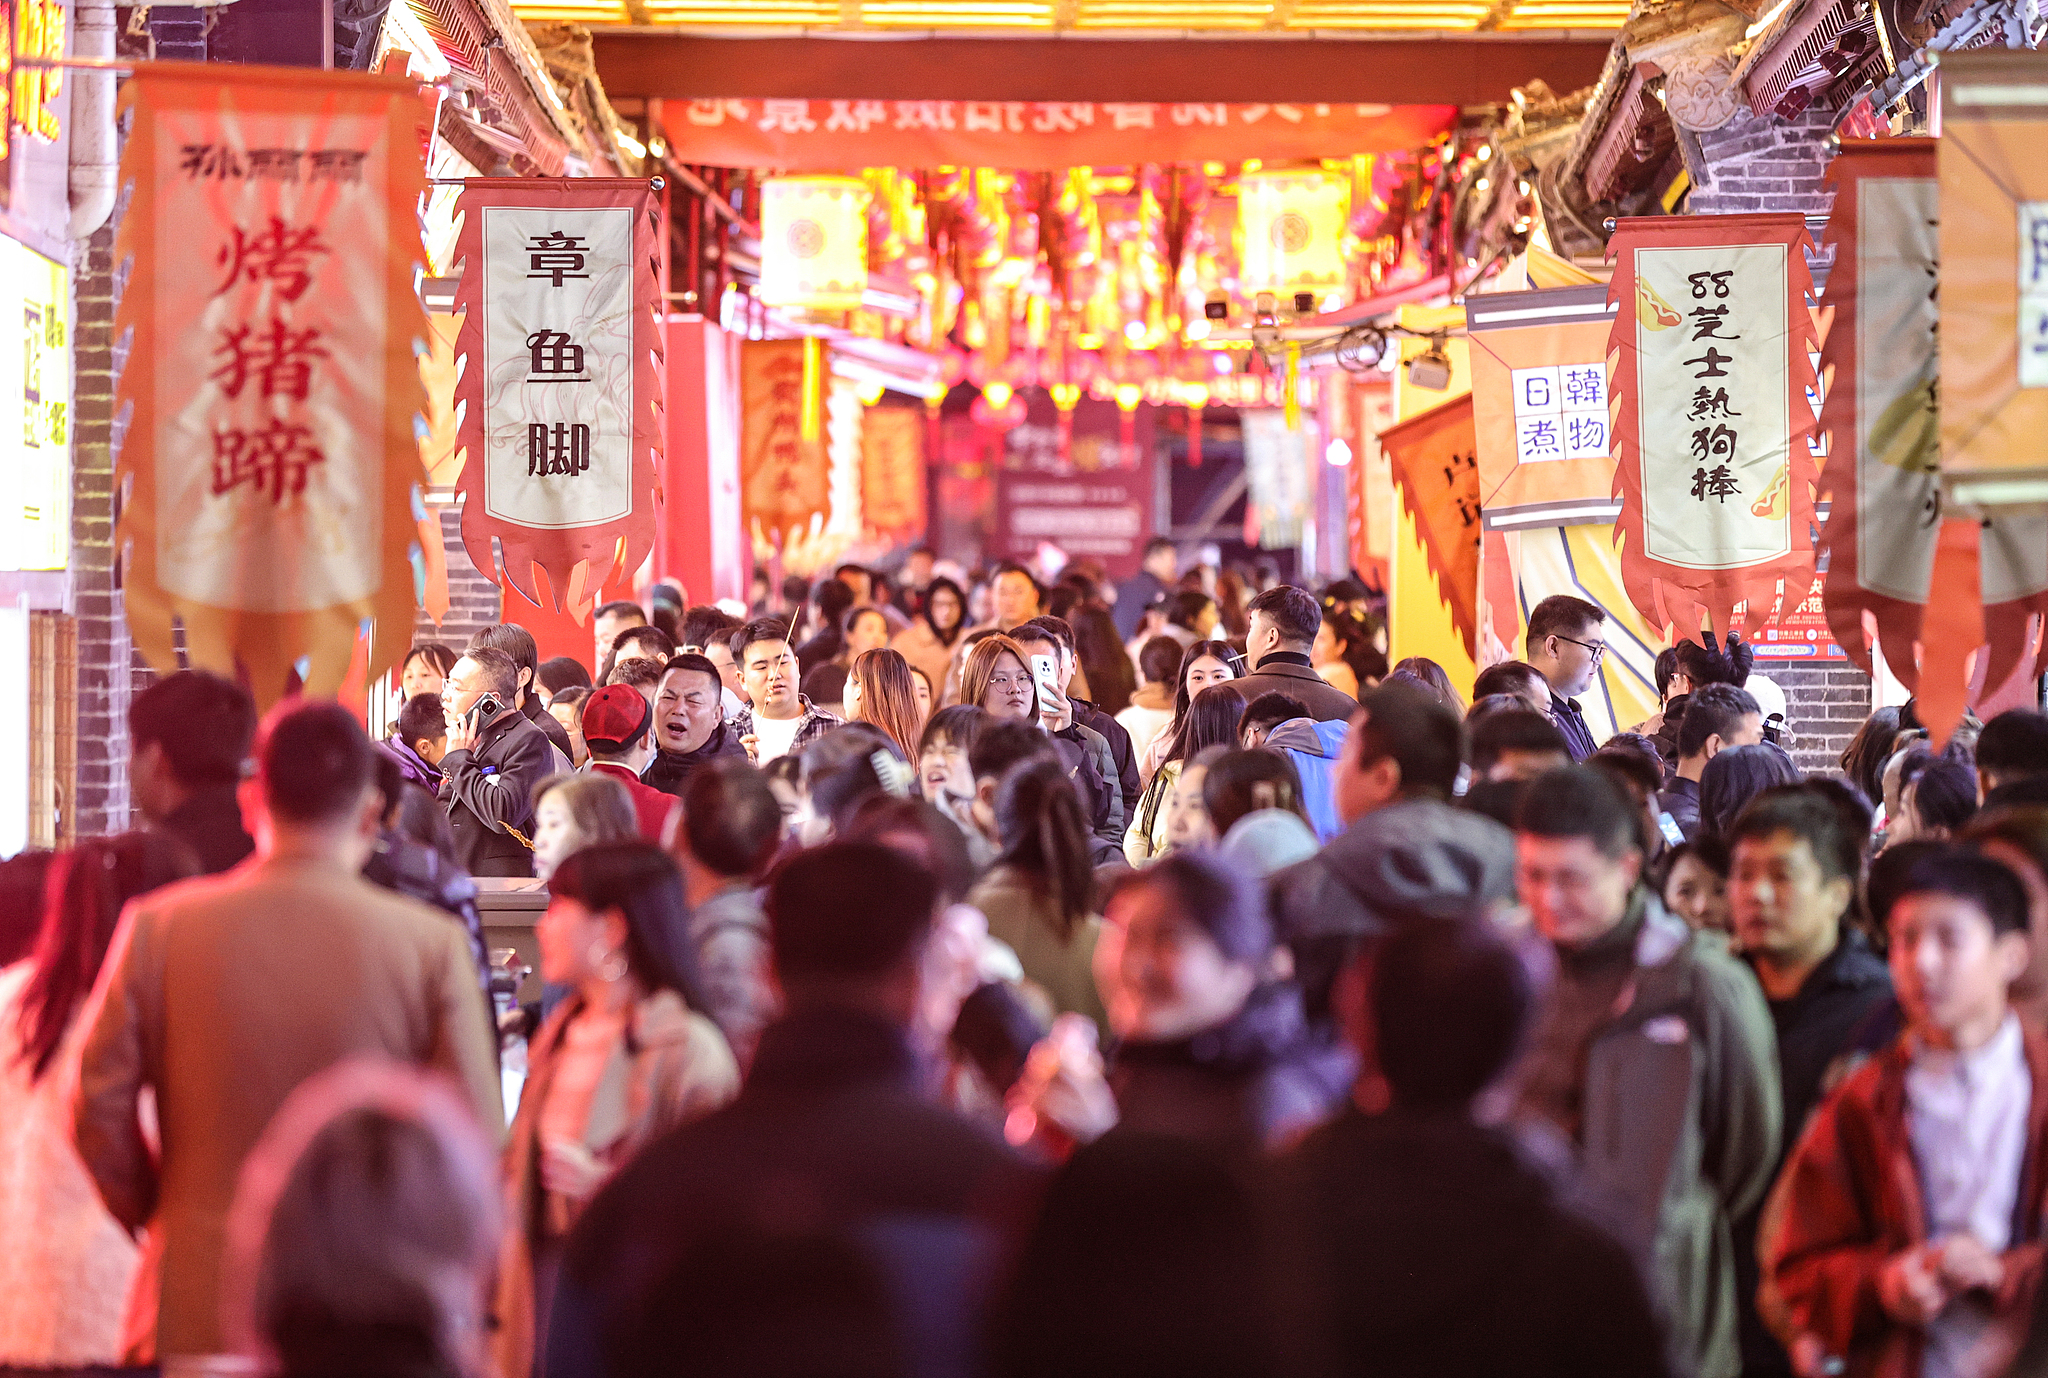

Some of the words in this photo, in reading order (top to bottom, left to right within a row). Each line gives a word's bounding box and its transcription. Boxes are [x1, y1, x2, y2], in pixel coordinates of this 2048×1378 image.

[209, 215, 331, 506] 烤猪蹄
[526, 231, 591, 477] 章鱼脚
